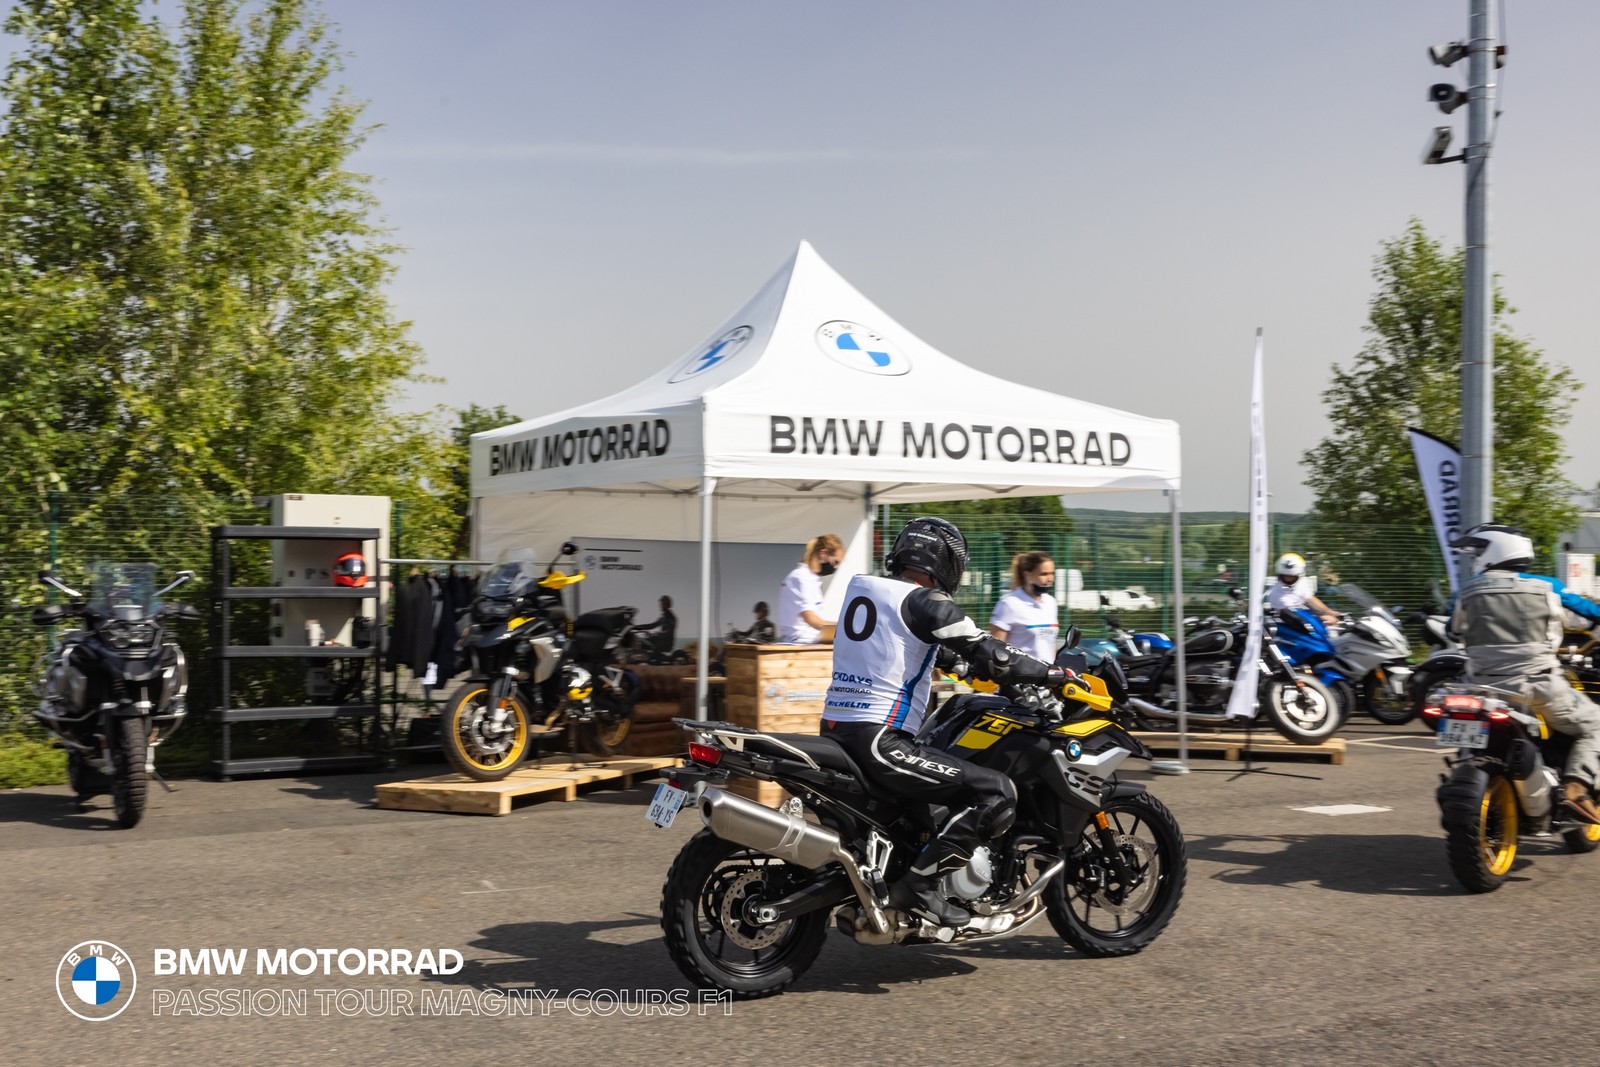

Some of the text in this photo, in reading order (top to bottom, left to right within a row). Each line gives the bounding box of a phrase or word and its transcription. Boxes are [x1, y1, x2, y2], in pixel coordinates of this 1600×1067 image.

[490, 419, 672, 477] BMW MOTORRAD
[770, 415, 1132, 467] BMW MOTORRAD
[844, 596, 877, 641] 0
[888, 749, 962, 777] DAINESE
